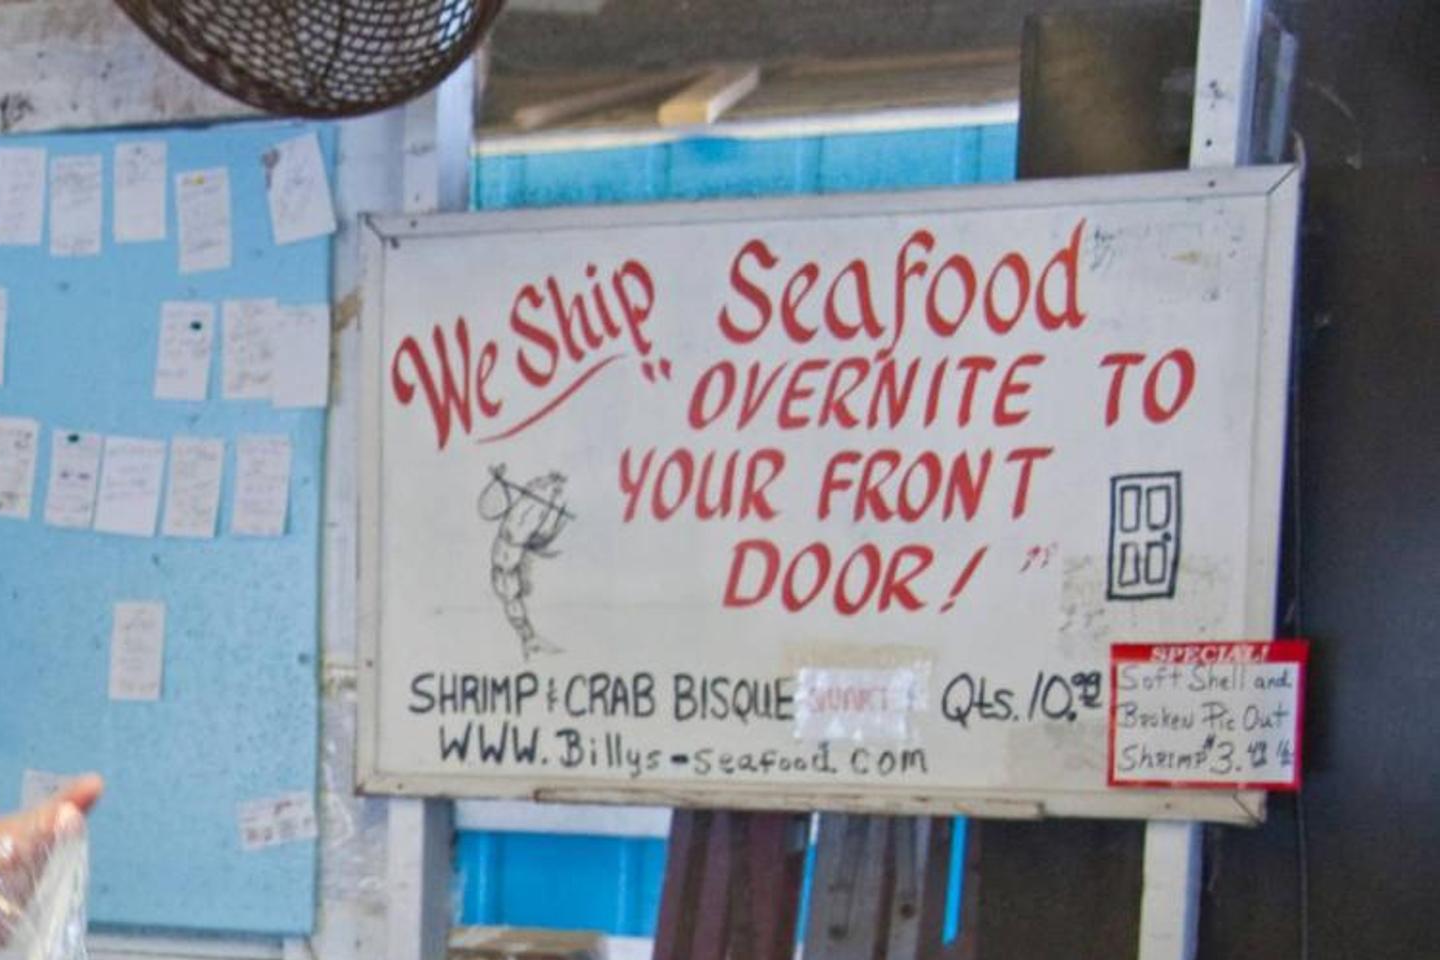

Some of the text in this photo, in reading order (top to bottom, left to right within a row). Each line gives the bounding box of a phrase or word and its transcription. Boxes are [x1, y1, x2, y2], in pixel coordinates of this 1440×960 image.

[391, 316, 503, 451] We
[510, 259, 656, 388] Ship
[717, 218, 1088, 356] Seafood
[1098, 348, 1197, 428] TO
[618, 445, 1055, 523] YOUR FRONT
[1149, 645, 1272, 664] SPECIAL!
[1187, 663, 1246, 693] Shell
[408, 672, 541, 716] SHRIMP
[563, 671, 658, 719] CRAB
[672, 673, 795, 725] BISQUE
